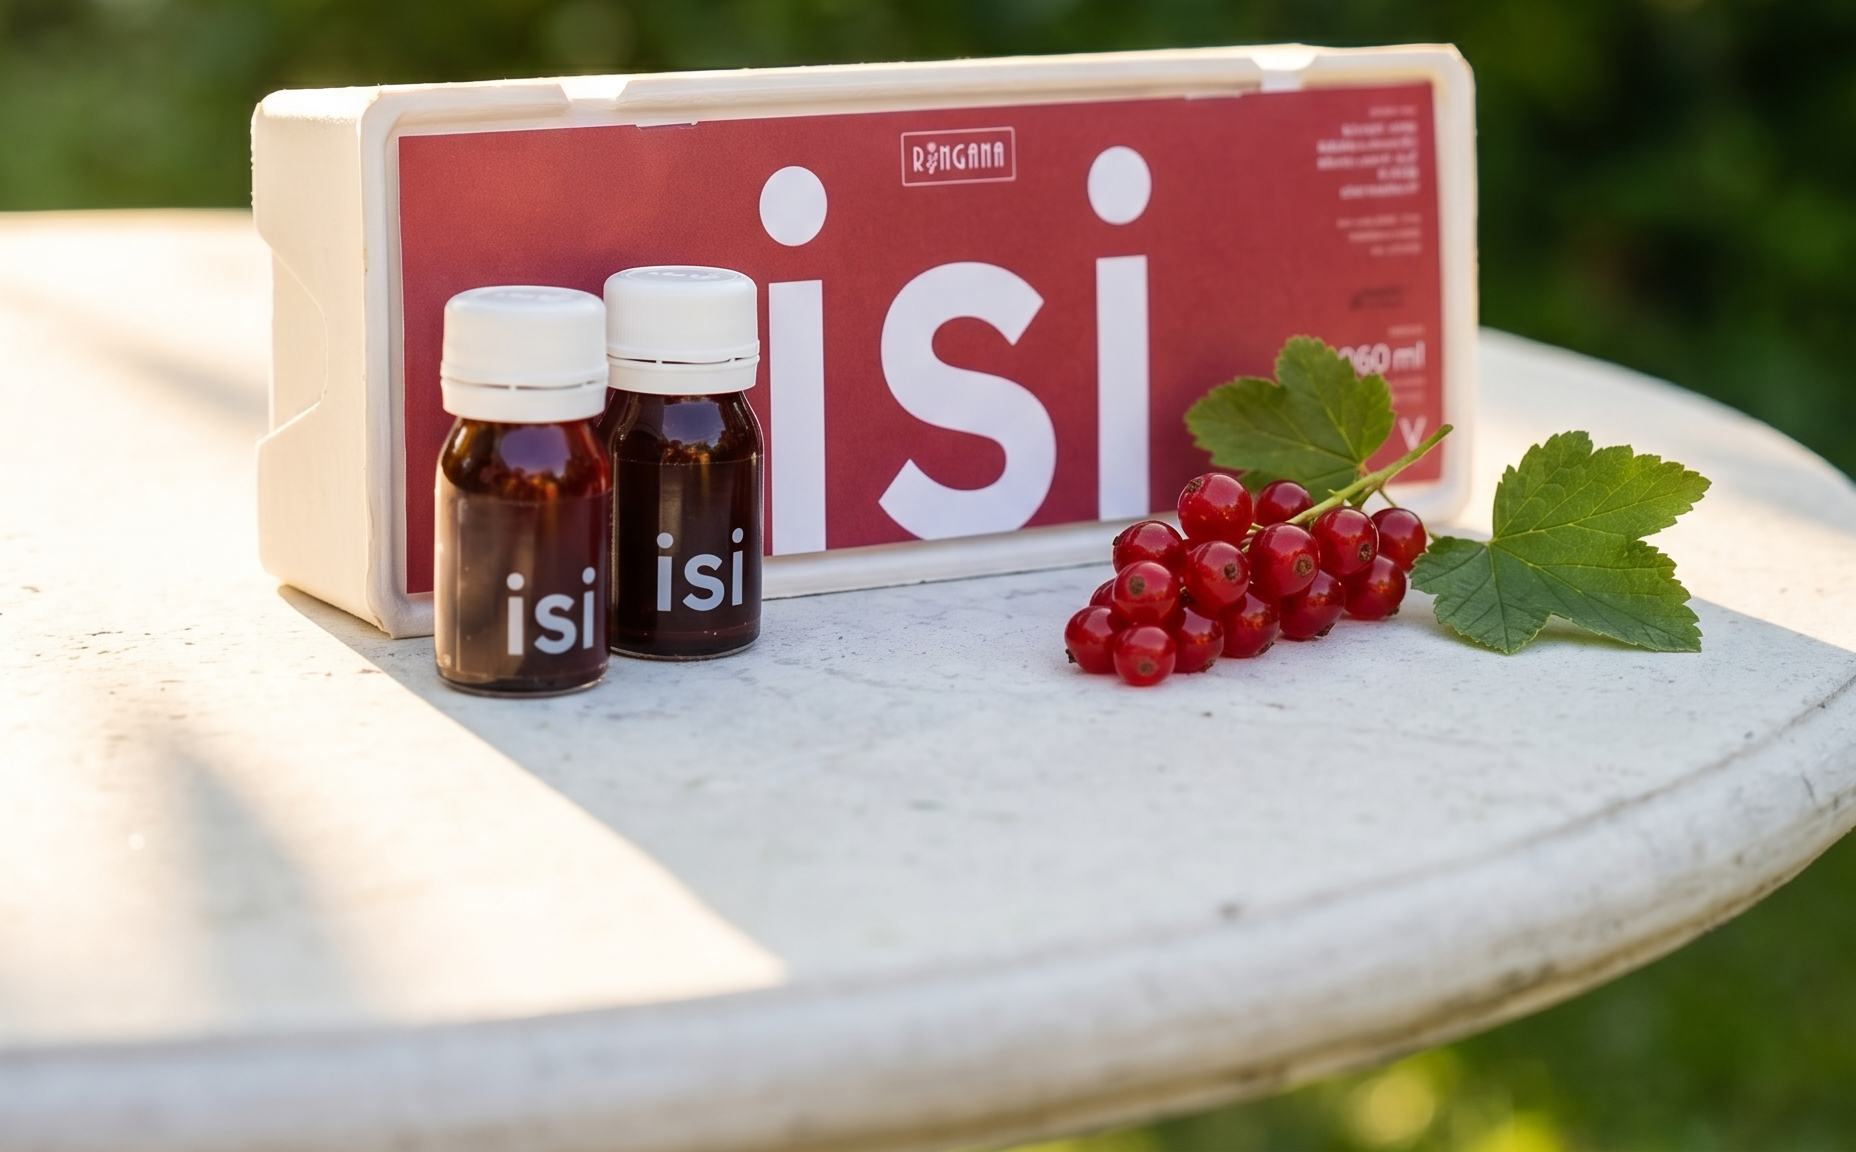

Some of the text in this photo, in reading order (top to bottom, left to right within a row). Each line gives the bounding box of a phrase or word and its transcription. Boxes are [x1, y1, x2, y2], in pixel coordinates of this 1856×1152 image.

[912, 141, 1005, 175] RINGANA
[759, 146, 1151, 557] isi
[1392, 340, 1426, 372] ml
[506, 566, 596, 657] isi
[656, 527, 744, 612] isi
